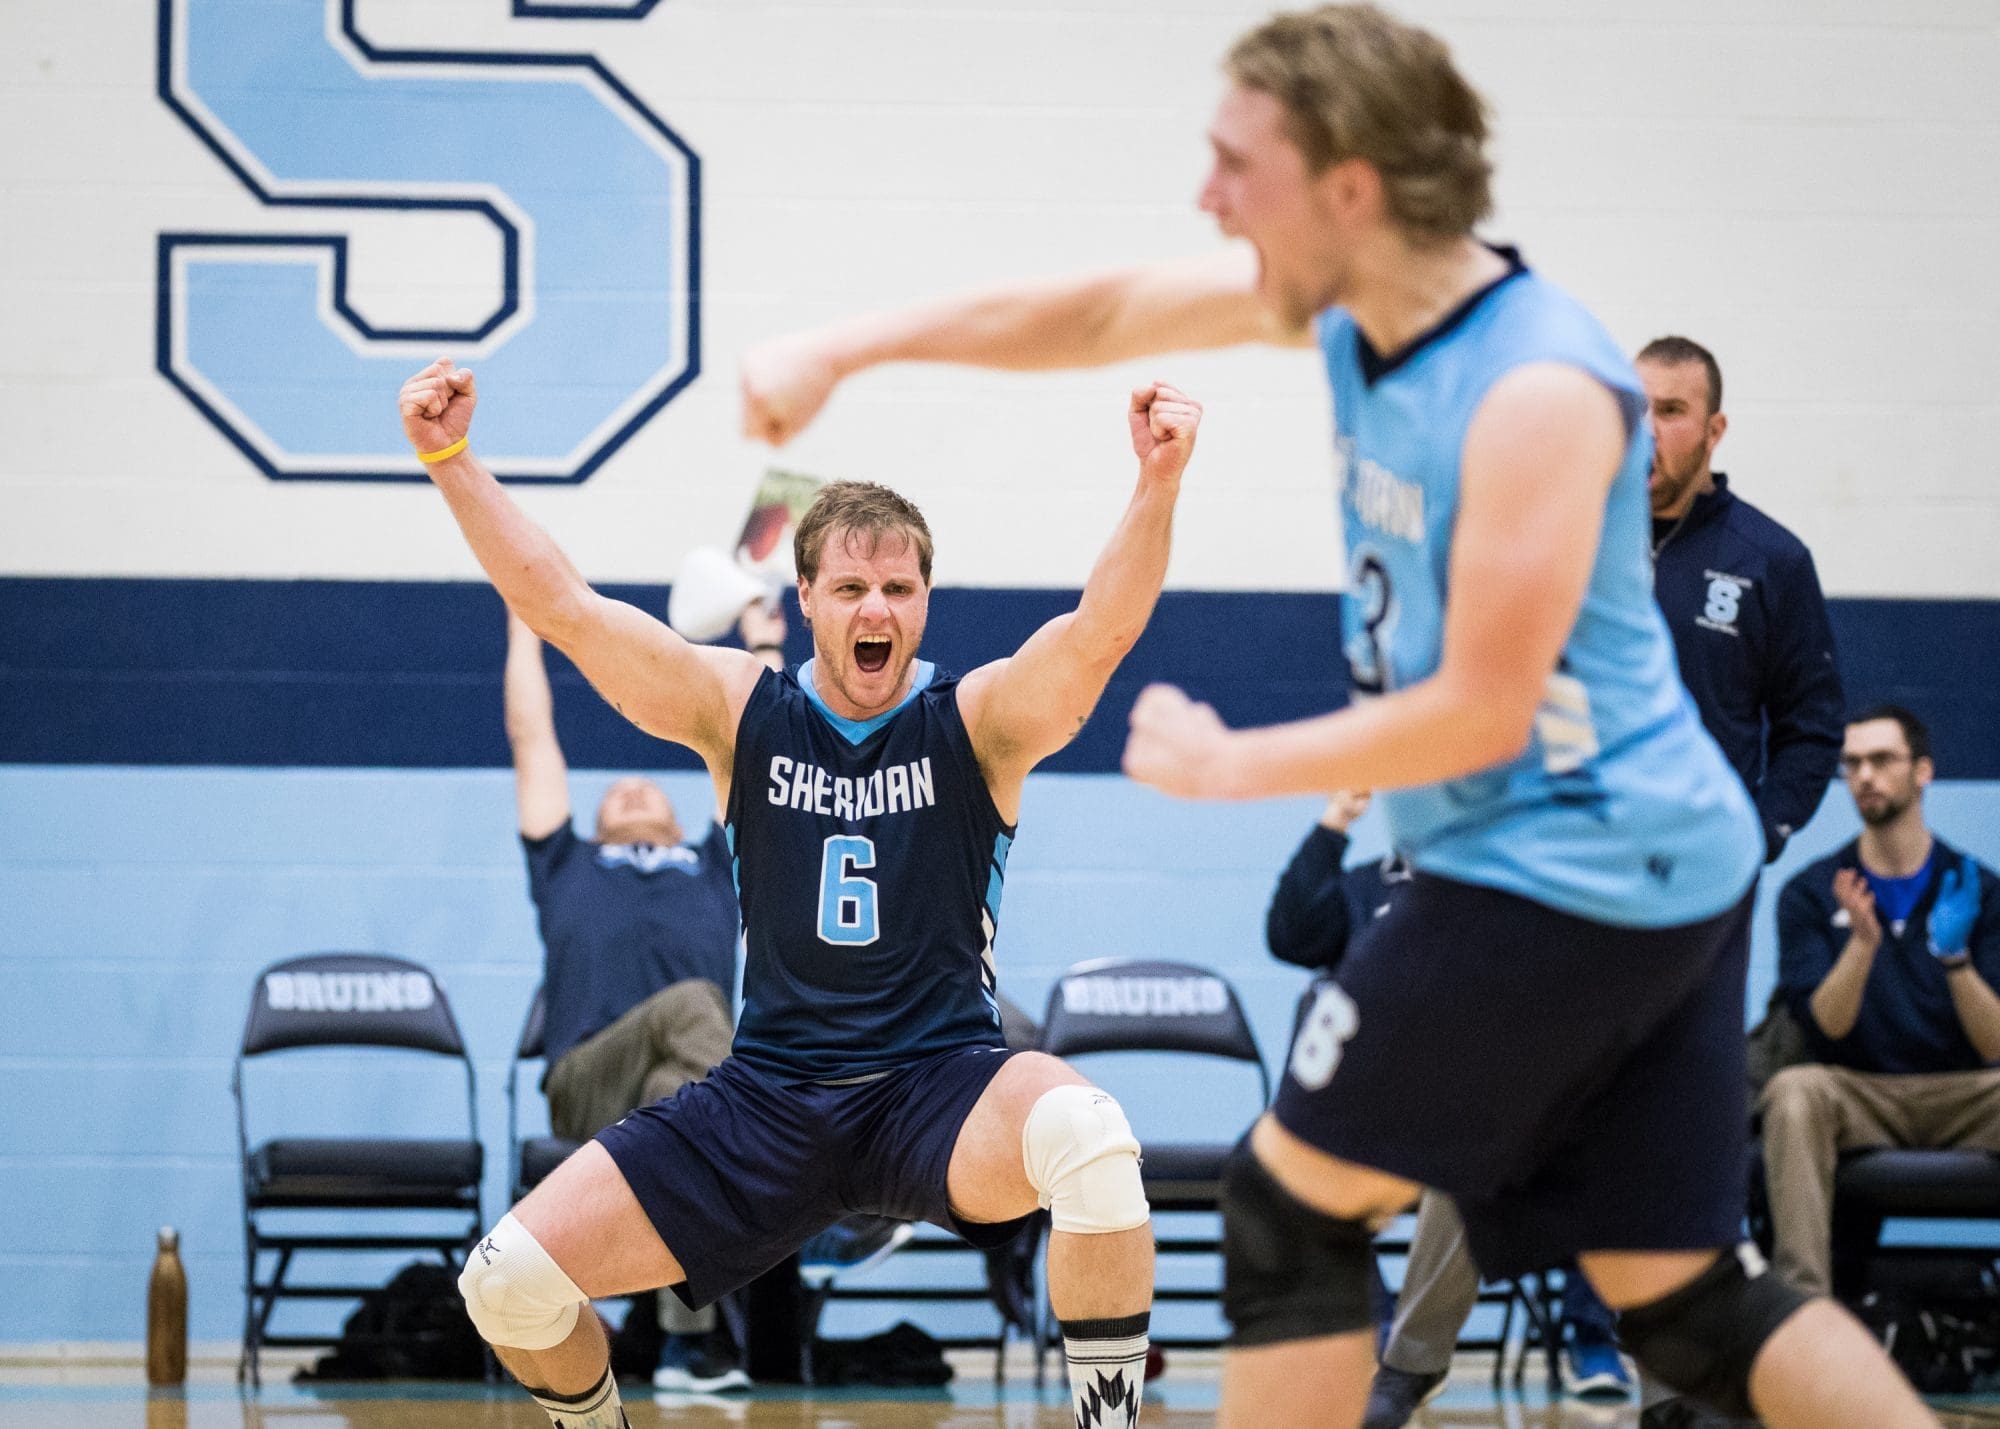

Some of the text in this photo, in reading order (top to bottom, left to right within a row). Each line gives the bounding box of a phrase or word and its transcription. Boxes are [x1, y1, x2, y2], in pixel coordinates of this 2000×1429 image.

[156, 0, 702, 485] S
[768, 755, 936, 821] SHERIDAN
[817, 834, 880, 946] 6
[265, 972, 435, 1011] BRUINS
[1063, 976, 1230, 1015] BRUINS
